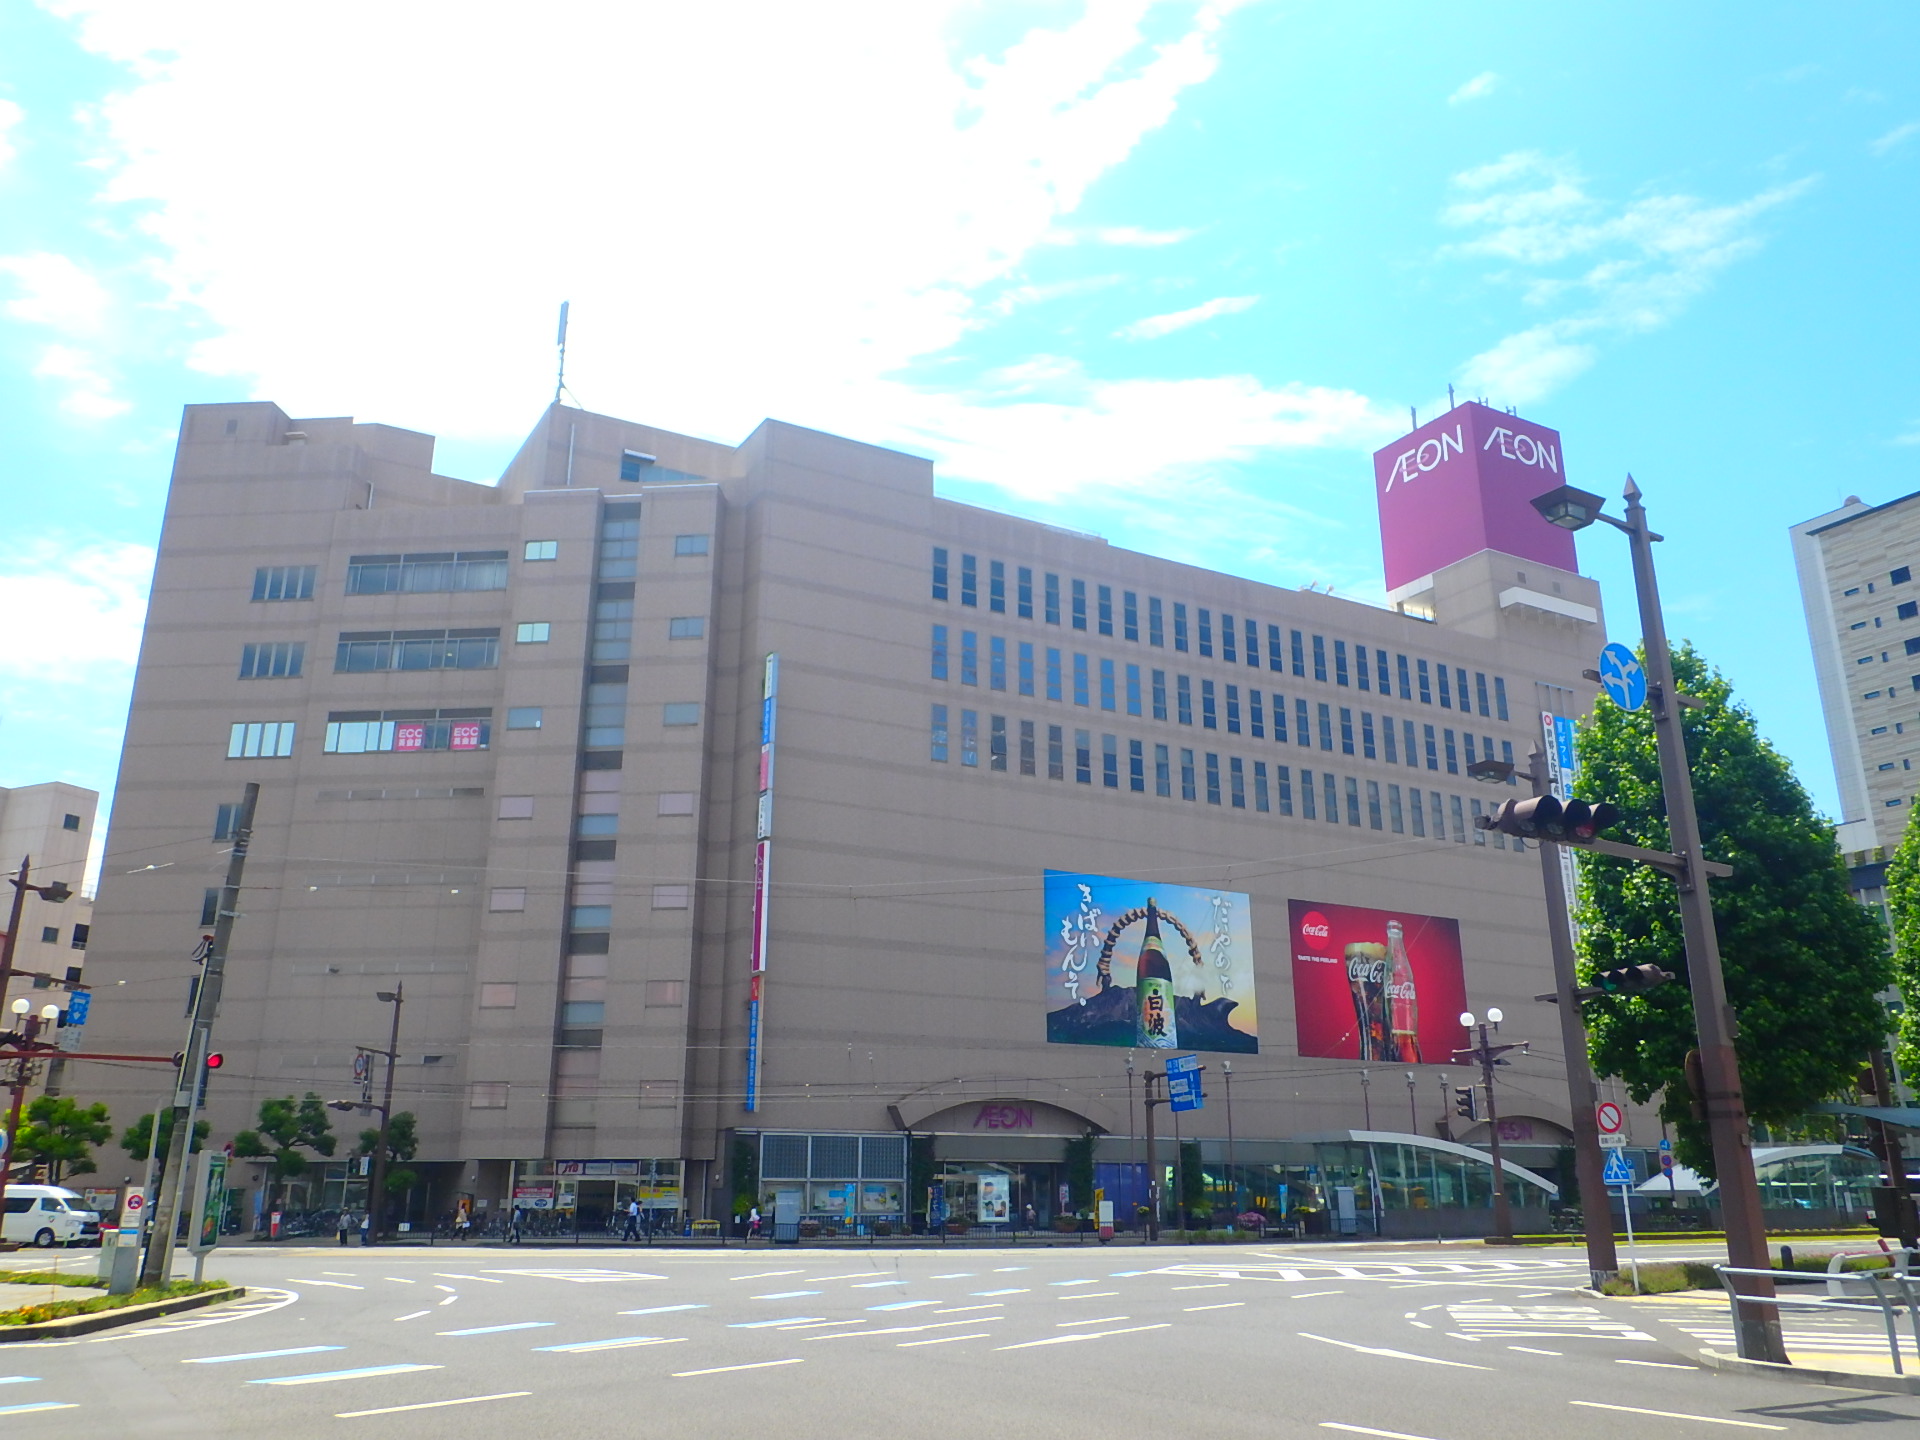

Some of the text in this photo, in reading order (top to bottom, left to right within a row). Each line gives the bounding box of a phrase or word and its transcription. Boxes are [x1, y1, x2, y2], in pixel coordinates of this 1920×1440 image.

[398, 728, 423, 738] ECC
[453, 727, 479, 736] ECC
[398, 738, 422, 747] 英会話
[453, 736, 478, 745] 英会話
[1077, 883, 1102, 948] きばい
[1297, 954, 1311, 962] TASTE
[1147, 988, 1168, 1037] 白波
